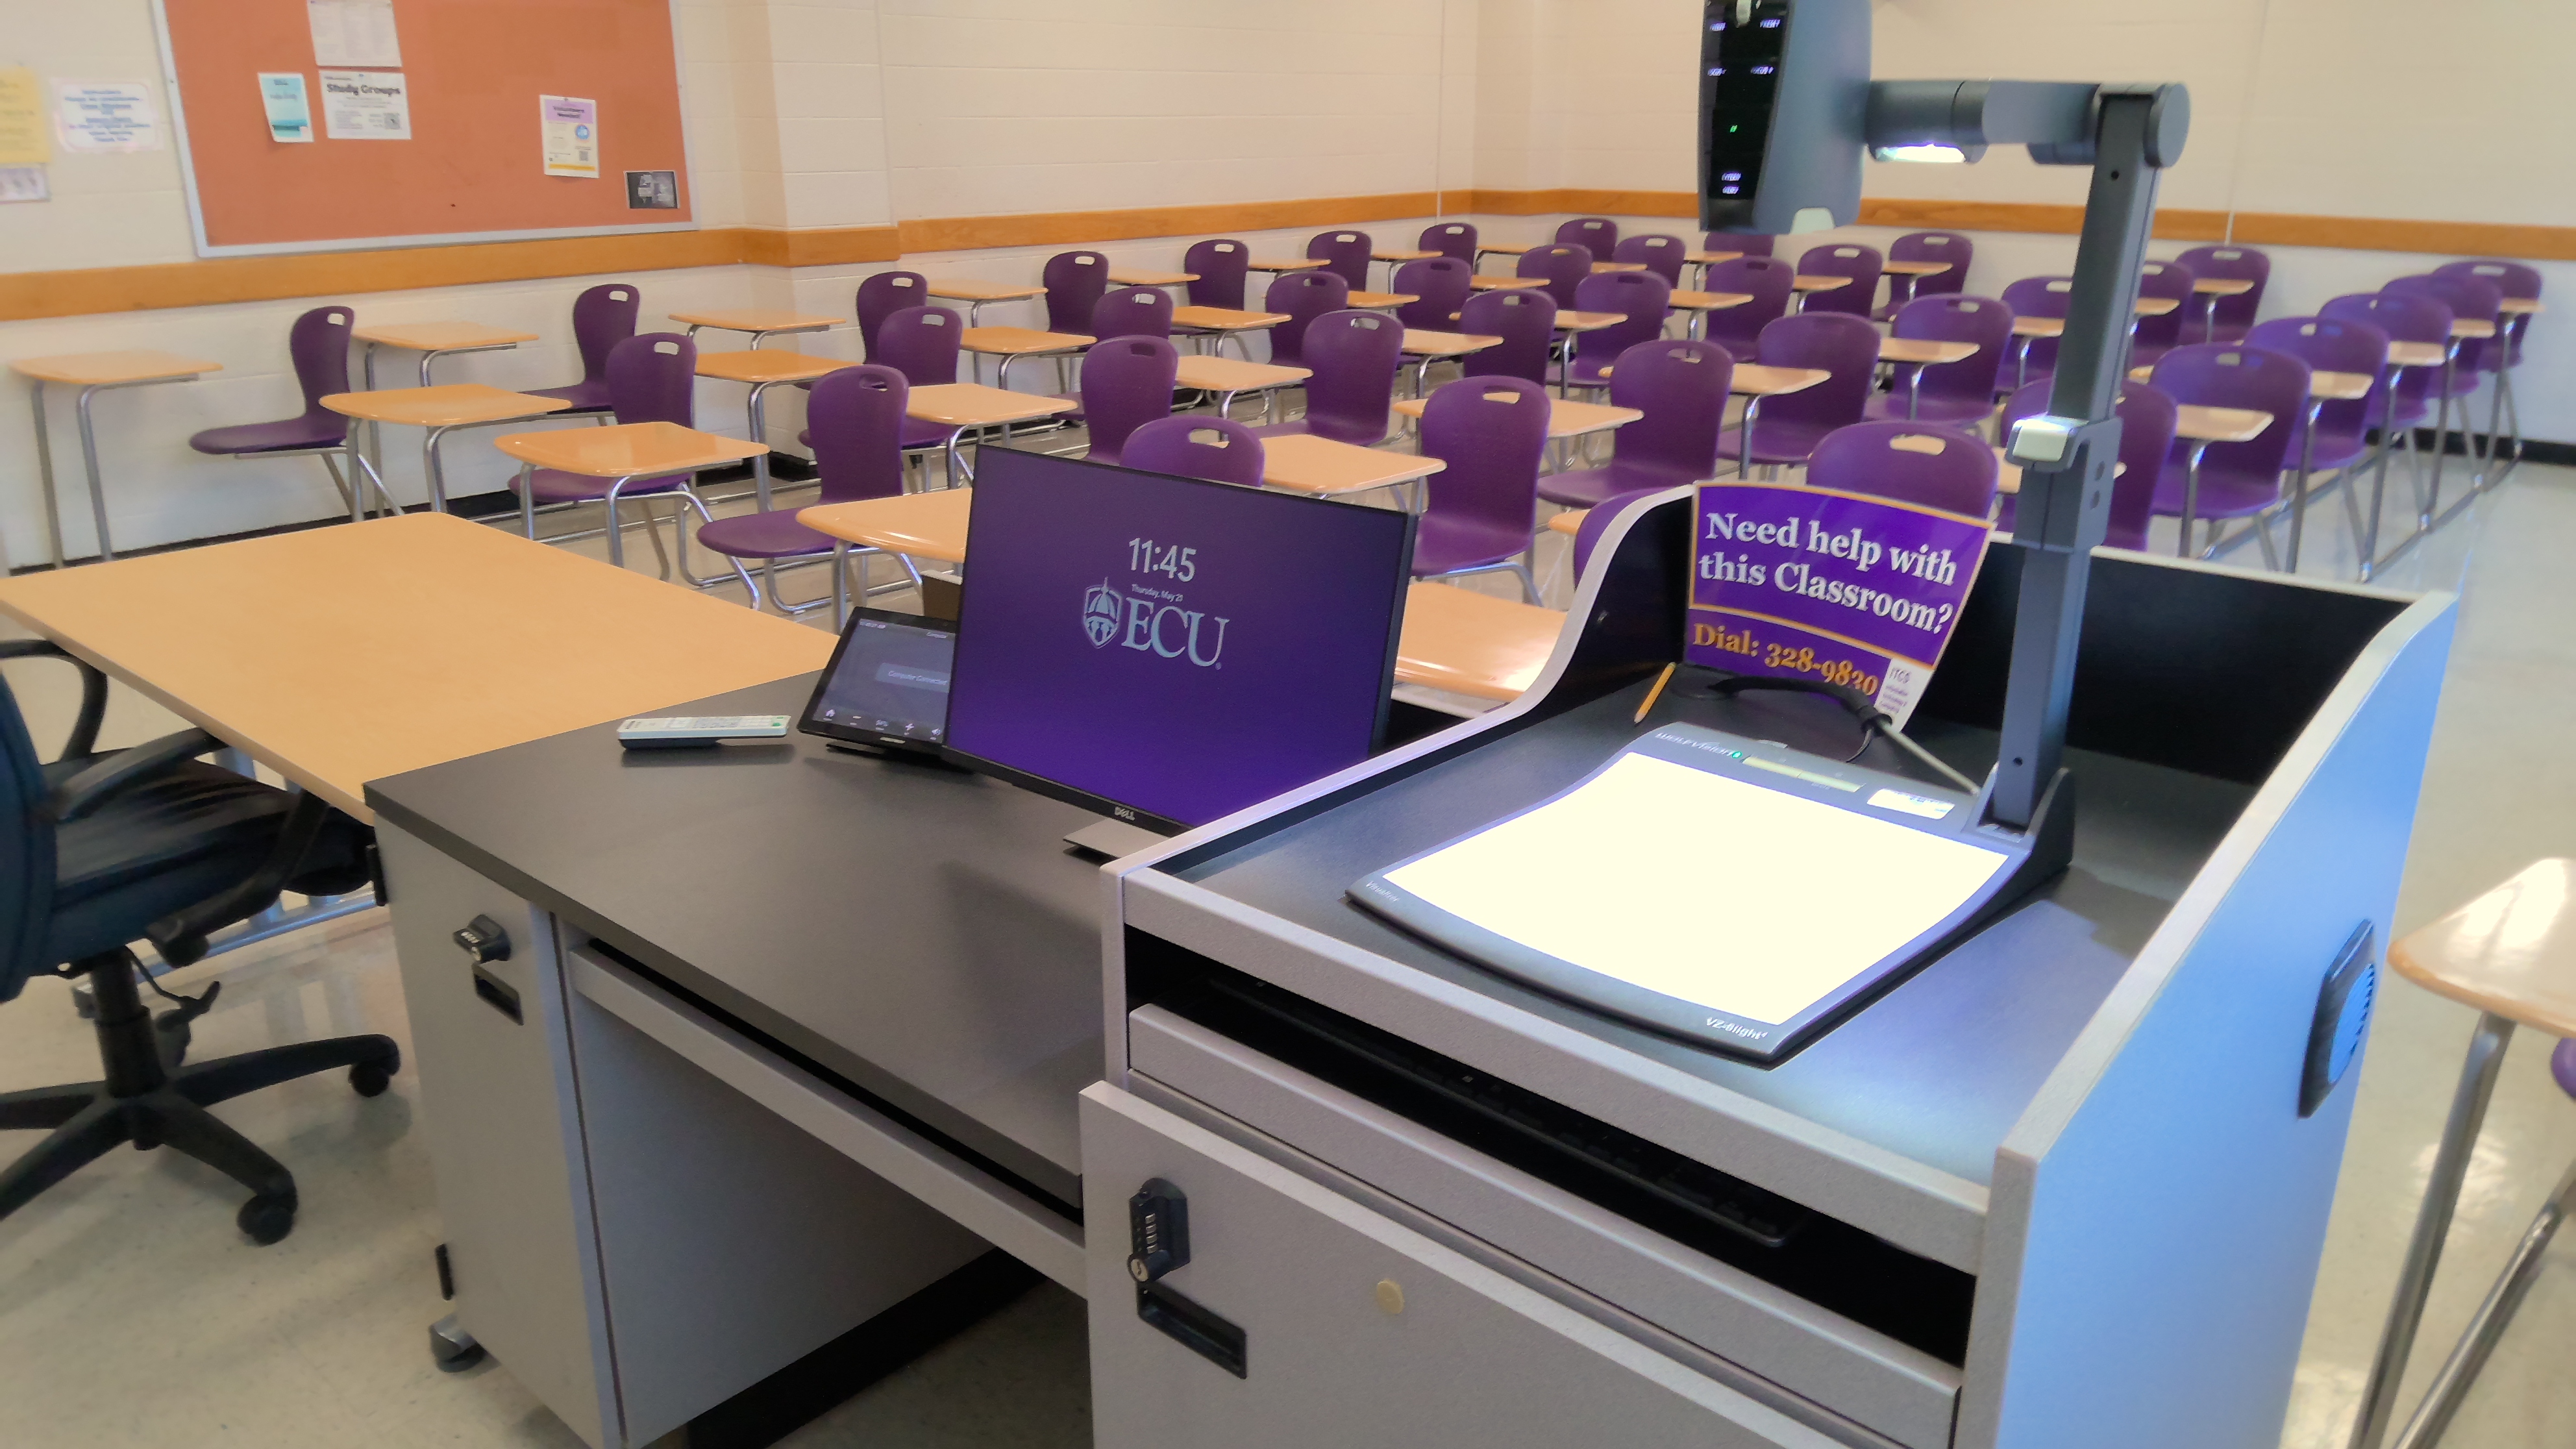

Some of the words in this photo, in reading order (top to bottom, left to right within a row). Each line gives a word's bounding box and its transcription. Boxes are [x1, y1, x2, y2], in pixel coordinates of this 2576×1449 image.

[327, 83, 359, 96] Study
[360, 84, 401, 97] Groups
[1129, 538, 1197, 582] 11:45
[1705, 512, 1800, 549] Need
[1807, 520, 1881, 572] help
[1888, 543, 1958, 586] with
[1160, 589, 1176, 602] May
[1698, 551, 1766, 586] this
[1774, 562, 1953, 634] Classroom?
[1121, 597, 1230, 667] ECU
[1693, 623, 1760, 658] Dial:
[1765, 643, 1880, 697] 328-9830
[1114, 806, 1135, 821] DELL
